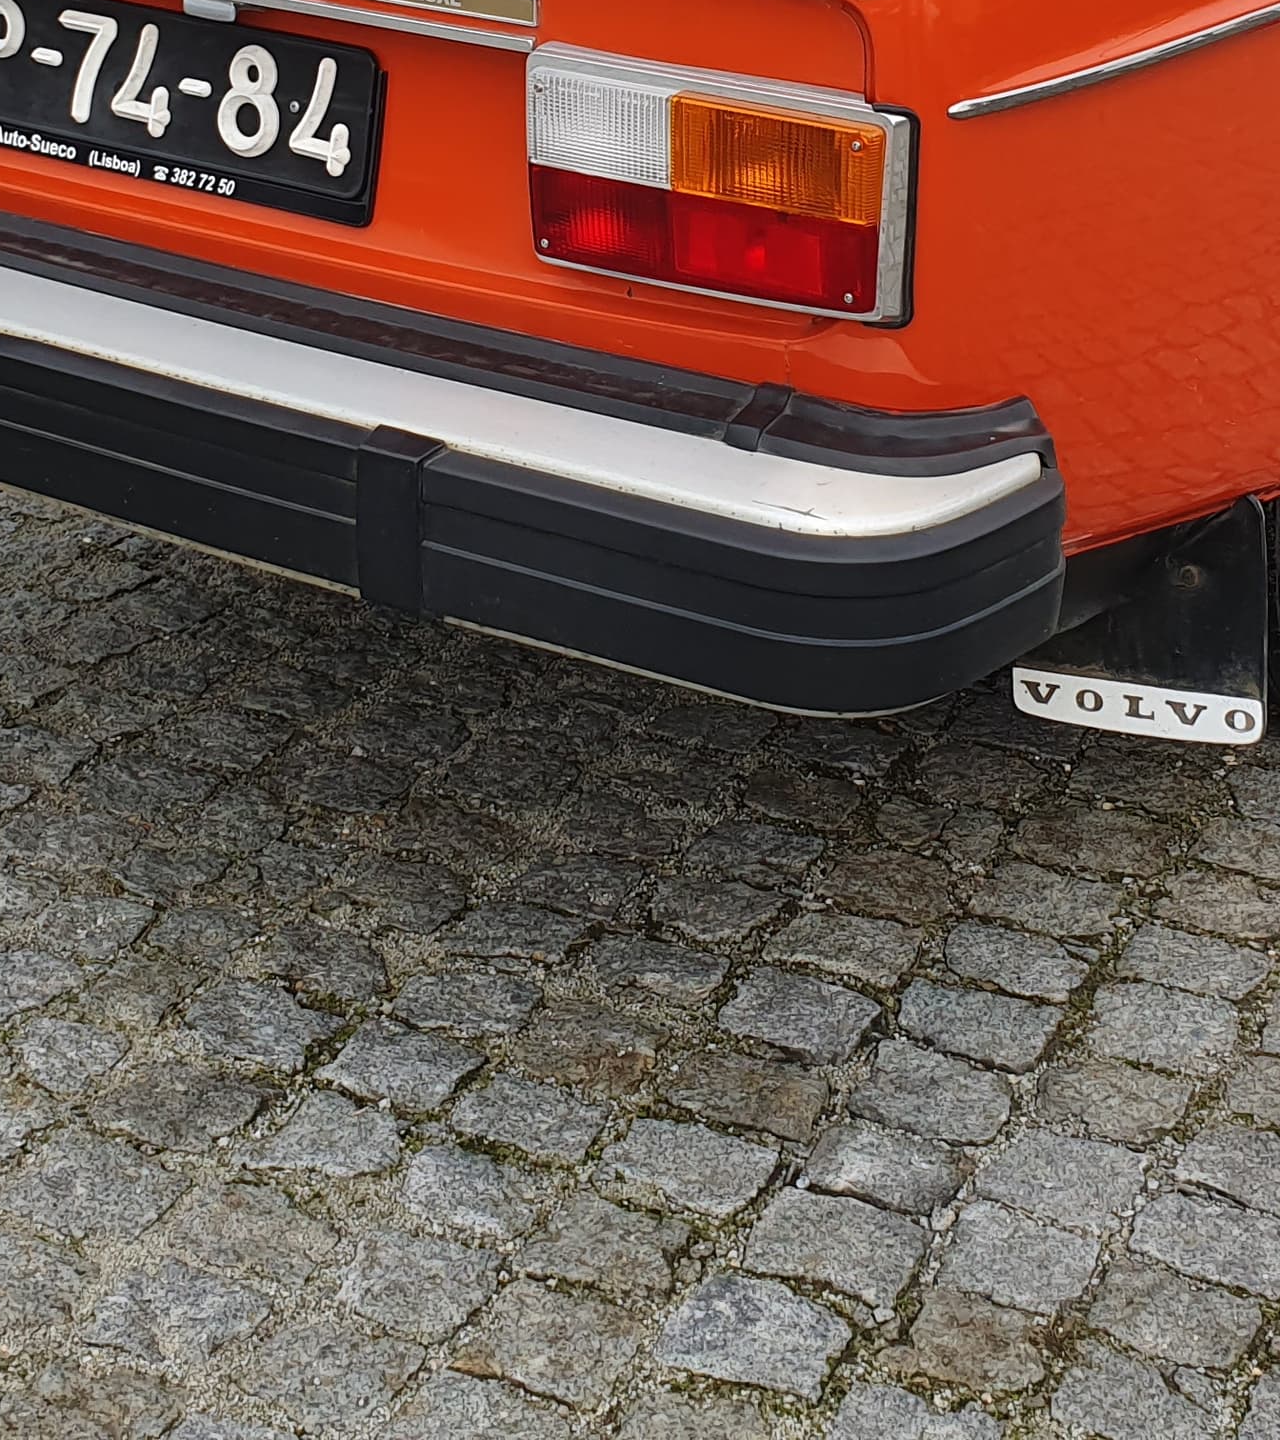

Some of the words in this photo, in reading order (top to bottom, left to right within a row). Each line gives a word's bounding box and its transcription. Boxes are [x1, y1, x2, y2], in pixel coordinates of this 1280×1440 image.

[88, 149, 141, 177] (Lisboa)
[170, 167, 196, 188] 382
[198, 172, 216, 192] 72
[217, 176, 236, 196] 50
[1020, 679, 1256, 733] VOLVO
